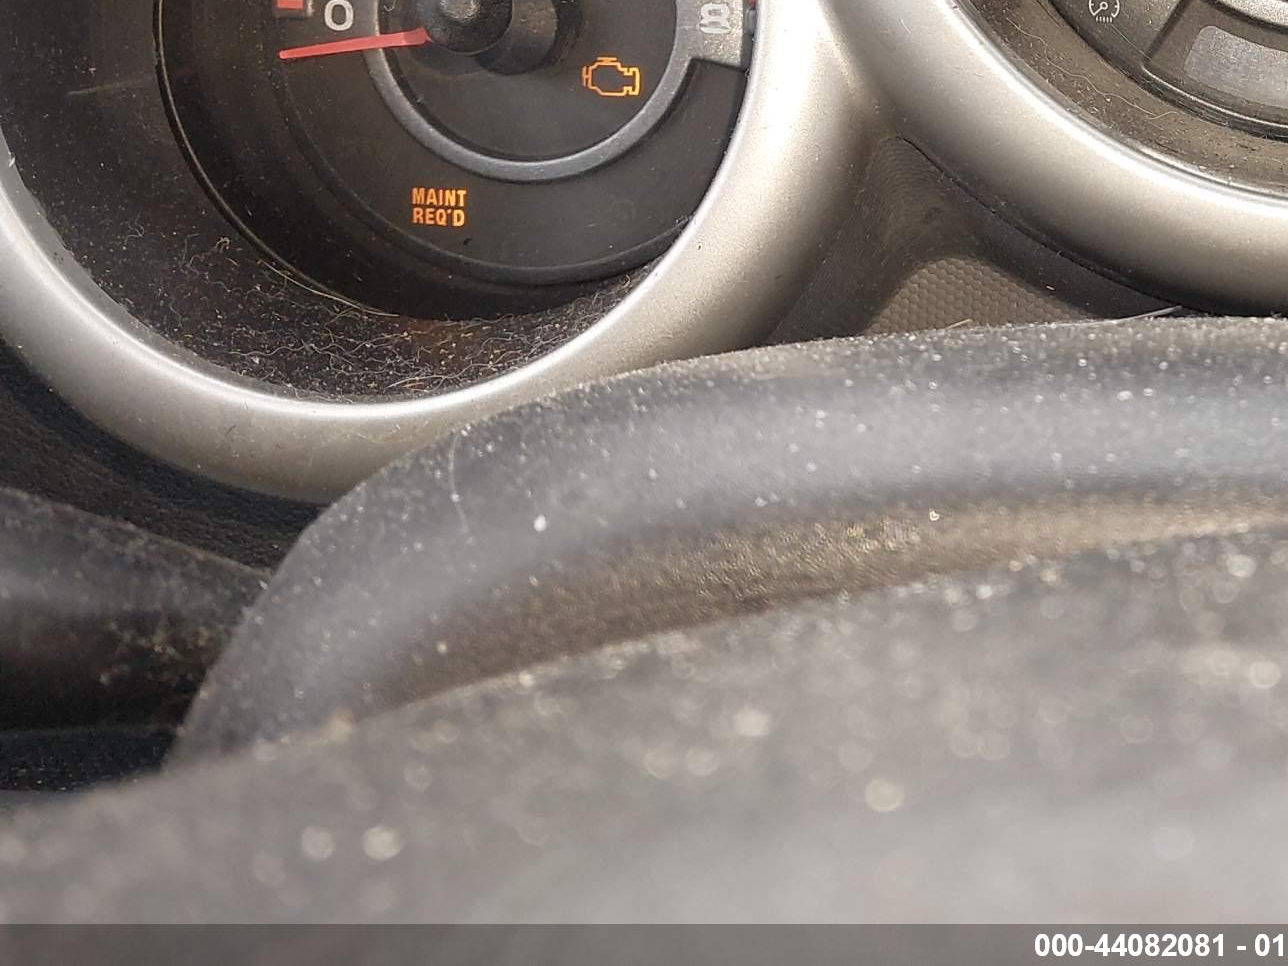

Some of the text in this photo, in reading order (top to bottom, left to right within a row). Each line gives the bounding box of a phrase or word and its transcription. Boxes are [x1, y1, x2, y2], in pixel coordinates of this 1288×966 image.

[699, 3, 731, 35] 8
[411, 186, 467, 207] MAINT
[412, 207, 466, 227] REQ'D
